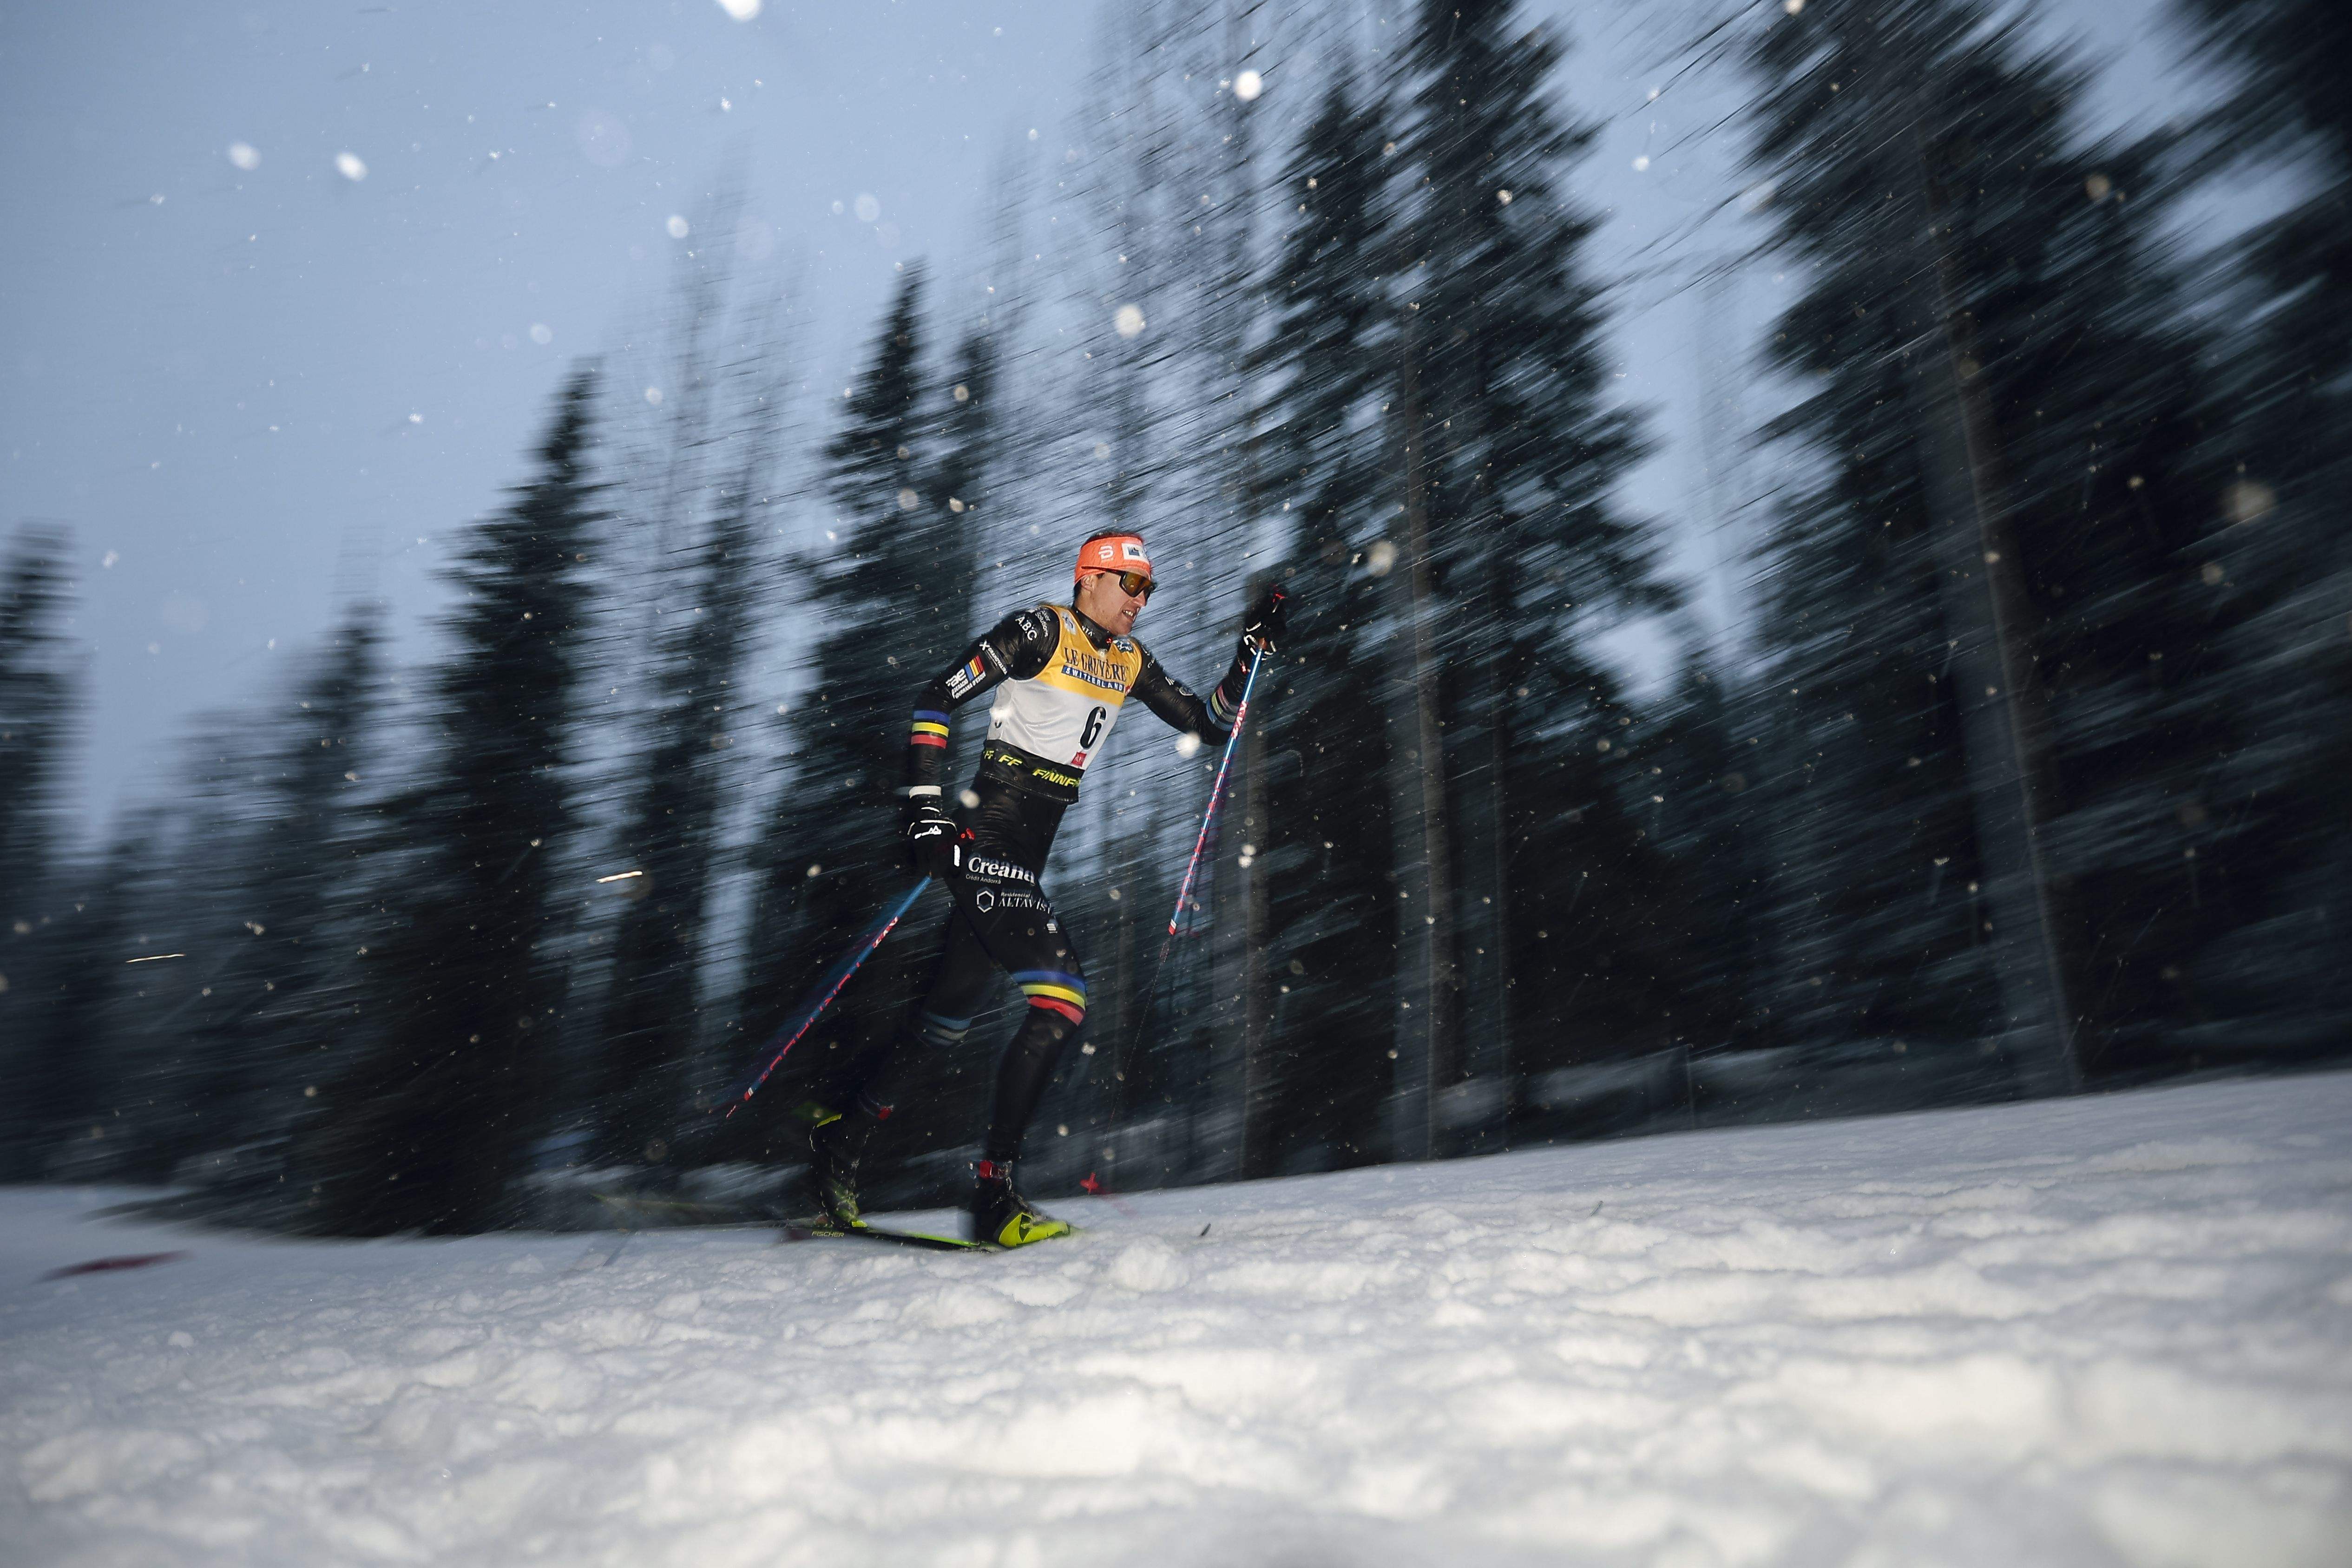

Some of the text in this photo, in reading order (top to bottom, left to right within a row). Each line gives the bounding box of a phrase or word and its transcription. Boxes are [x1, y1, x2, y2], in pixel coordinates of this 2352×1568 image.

[1064, 647, 1079, 666] LE
[1081, 653, 1126, 682] GRUYÈRE
[1065, 668, 1123, 691] SWITZERLAND
[1080, 706, 1106, 750] 6
[998, 754, 1023, 766] FF
